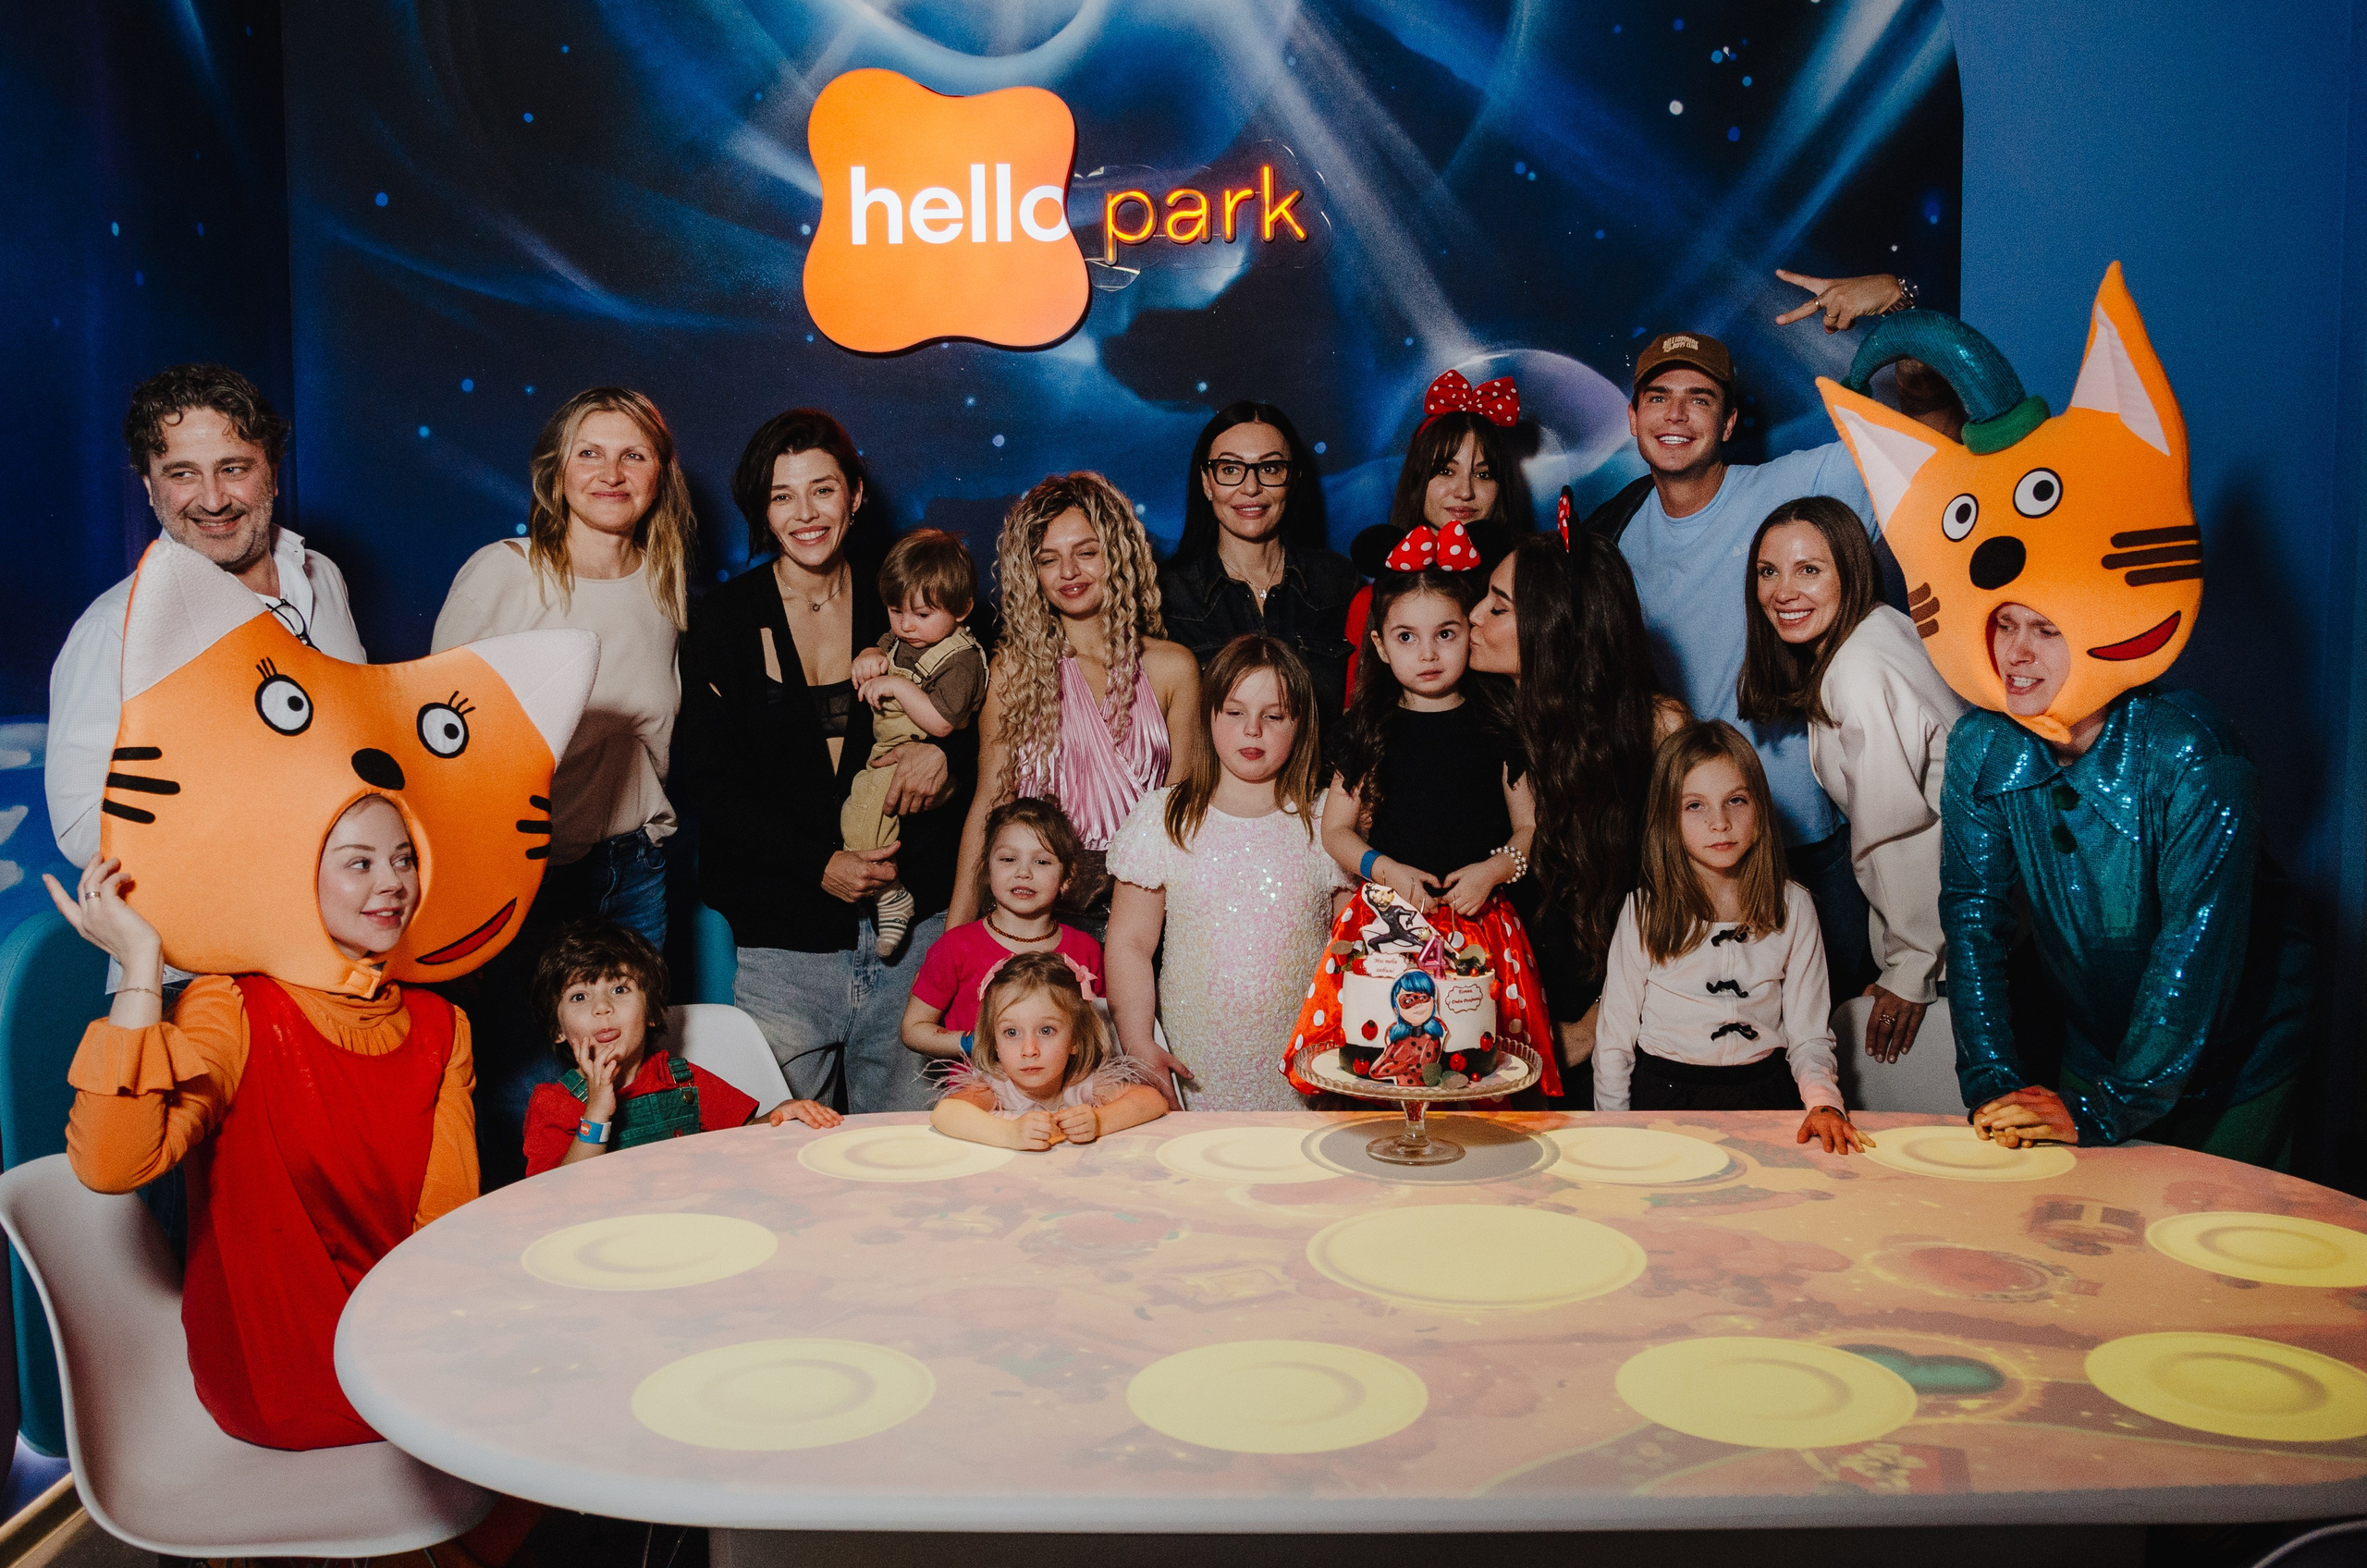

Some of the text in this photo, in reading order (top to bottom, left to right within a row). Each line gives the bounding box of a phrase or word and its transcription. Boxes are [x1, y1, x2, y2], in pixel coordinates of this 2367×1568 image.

[850, 164, 1308, 265] hello park
[1417, 935, 1446, 979] 4
